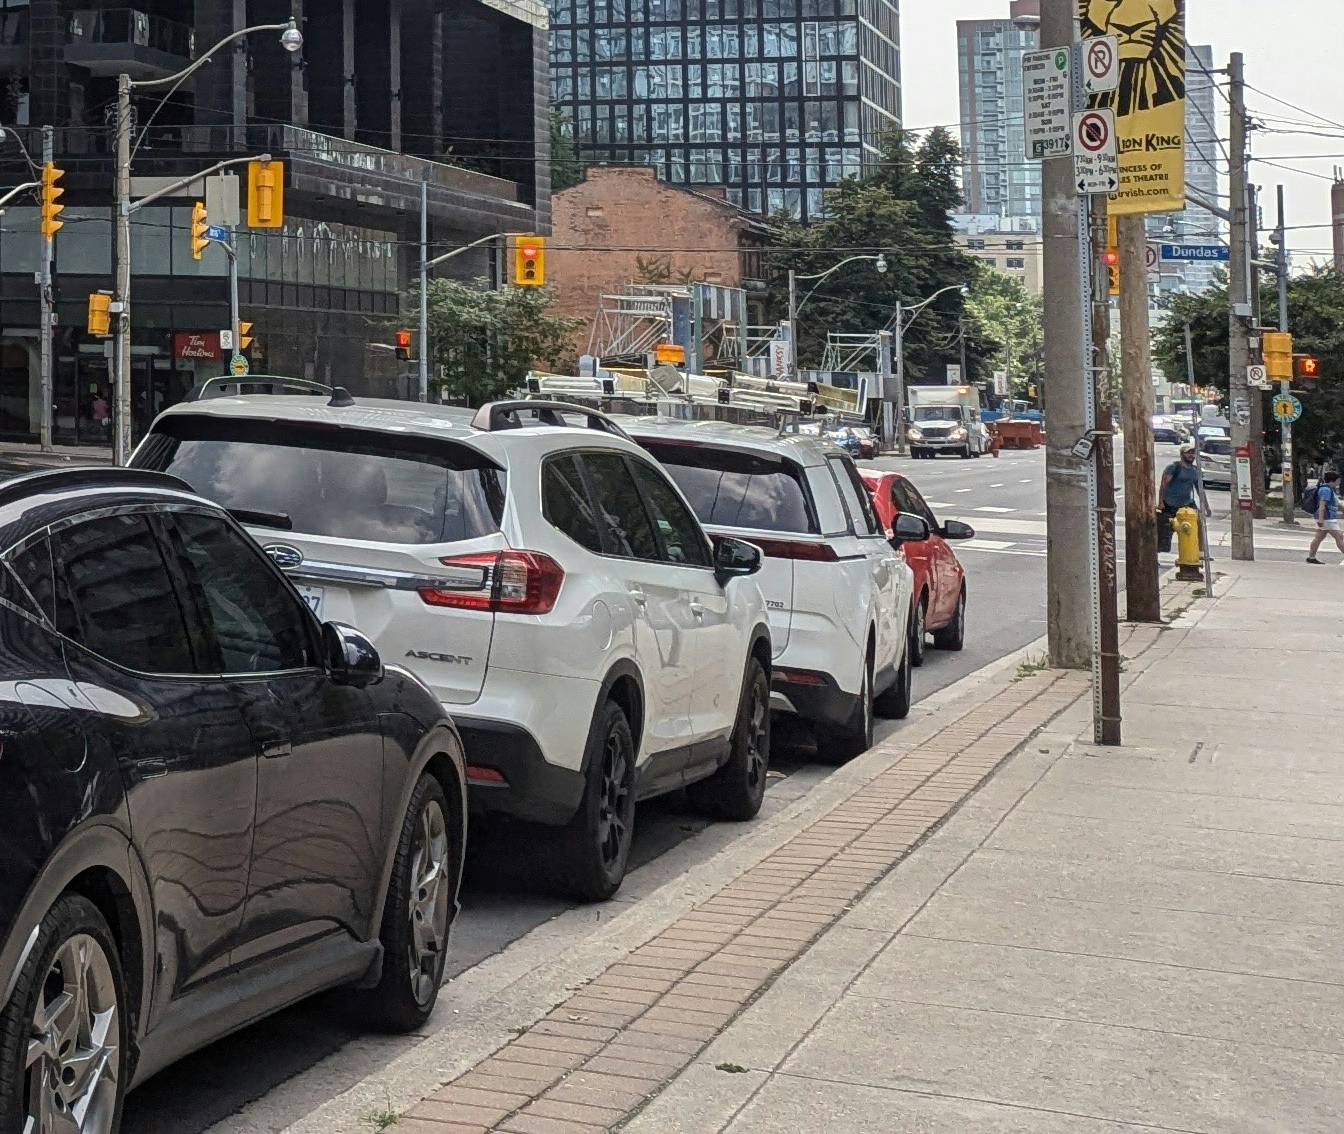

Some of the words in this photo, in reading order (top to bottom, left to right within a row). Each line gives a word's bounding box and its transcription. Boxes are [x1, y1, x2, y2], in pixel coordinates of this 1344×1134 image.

[1044, 137, 1065, 149] 3917
[1119, 164, 1148, 173] INCESS
[1172, 246, 1219, 257] Dundas
[404, 649, 473, 665] ASCENT
